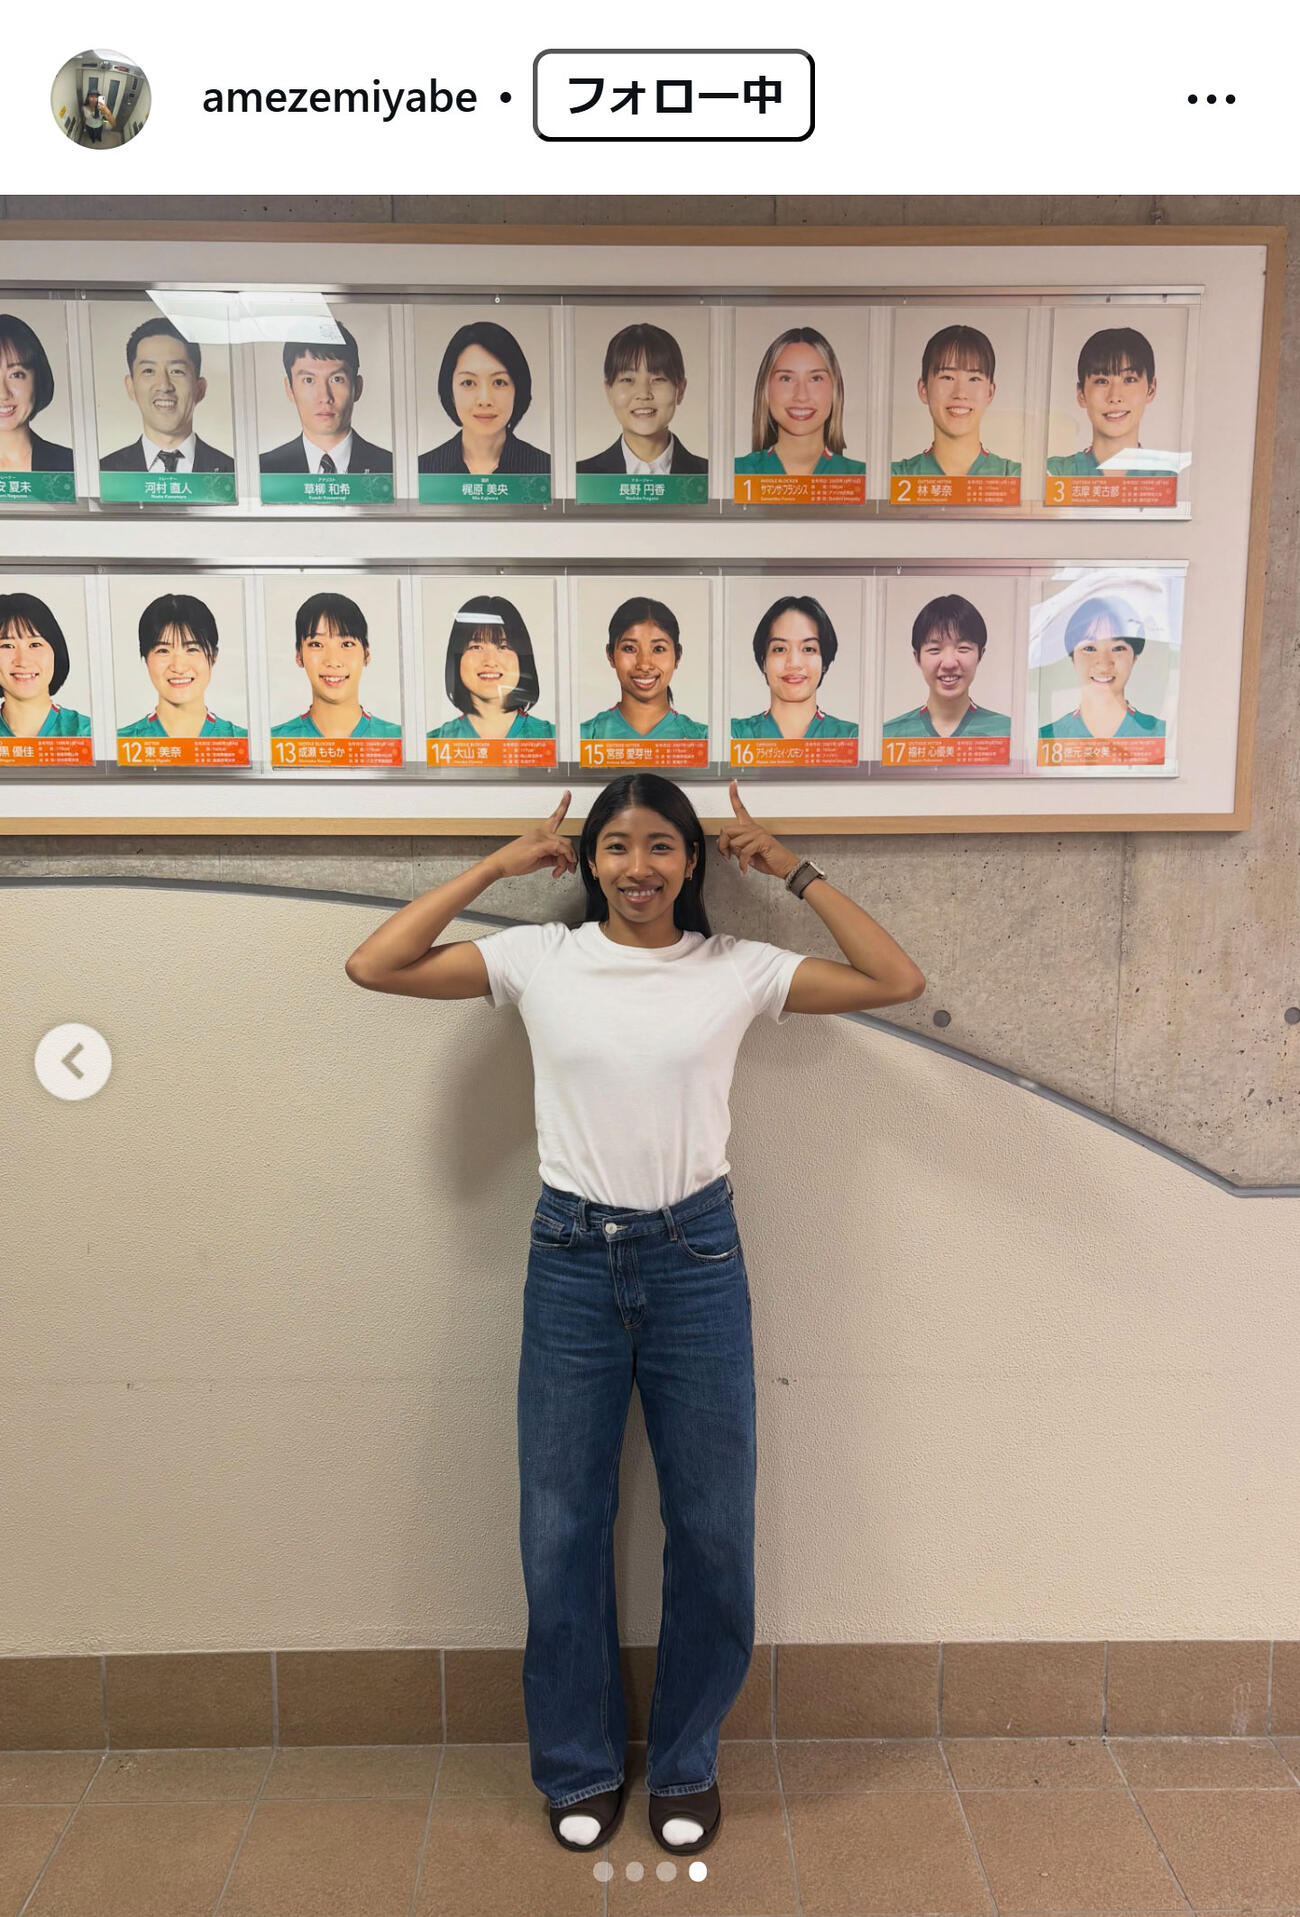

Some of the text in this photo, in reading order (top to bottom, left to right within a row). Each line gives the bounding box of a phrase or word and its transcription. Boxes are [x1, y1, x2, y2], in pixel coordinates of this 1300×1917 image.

[145, 482, 192, 494] 河村 直人
[304, 483, 351, 495] 草柳 和希
[462, 484, 509, 496] 梶原 美央
[619, 484, 665, 496] 長野 円香
[743, 480, 751, 500] 1
[897, 480, 911, 501] 2
[917, 485, 927, 496] 林
[1053, 481, 1065, 502] 3
[122, 742, 142, 763] 12
[145, 746, 156, 758] 東
[160, 746, 181, 758] 美奈
[276, 742, 296, 763] 13
[319, 747, 345, 758] ももか
[432, 743, 451, 764] 14
[453, 747, 474, 759] 大山
[584, 744, 605, 765] 15
[734, 744, 754, 764] 16
[886, 742, 905, 763] 17
[1041, 743, 1063, 764] 18
